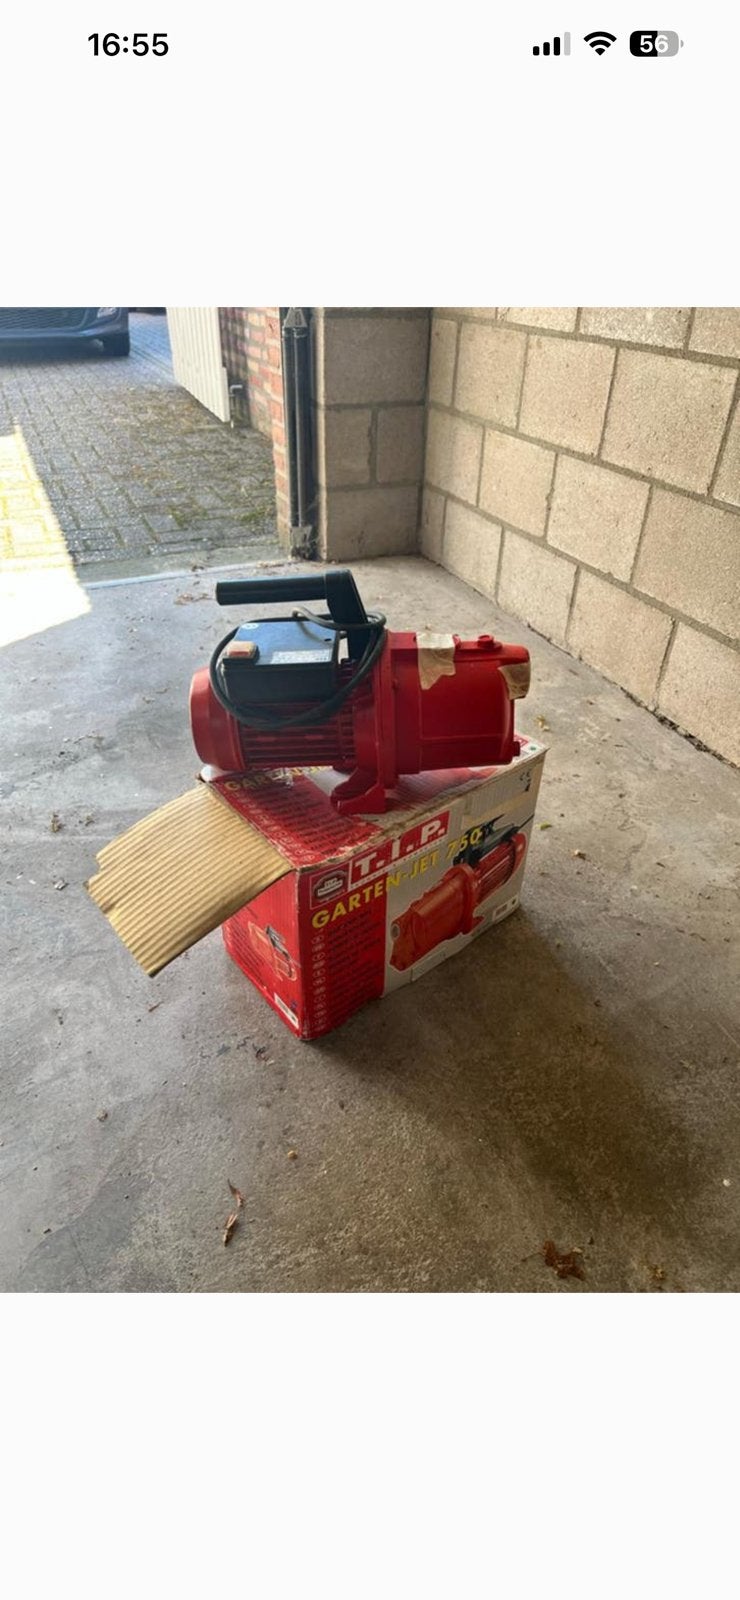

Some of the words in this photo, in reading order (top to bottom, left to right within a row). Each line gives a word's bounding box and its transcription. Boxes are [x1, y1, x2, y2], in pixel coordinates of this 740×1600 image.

[312, 849, 440, 929] GARTEN-JET
[446, 828, 483, 861] 750
[354, 820, 446, 876] T.I.P.
